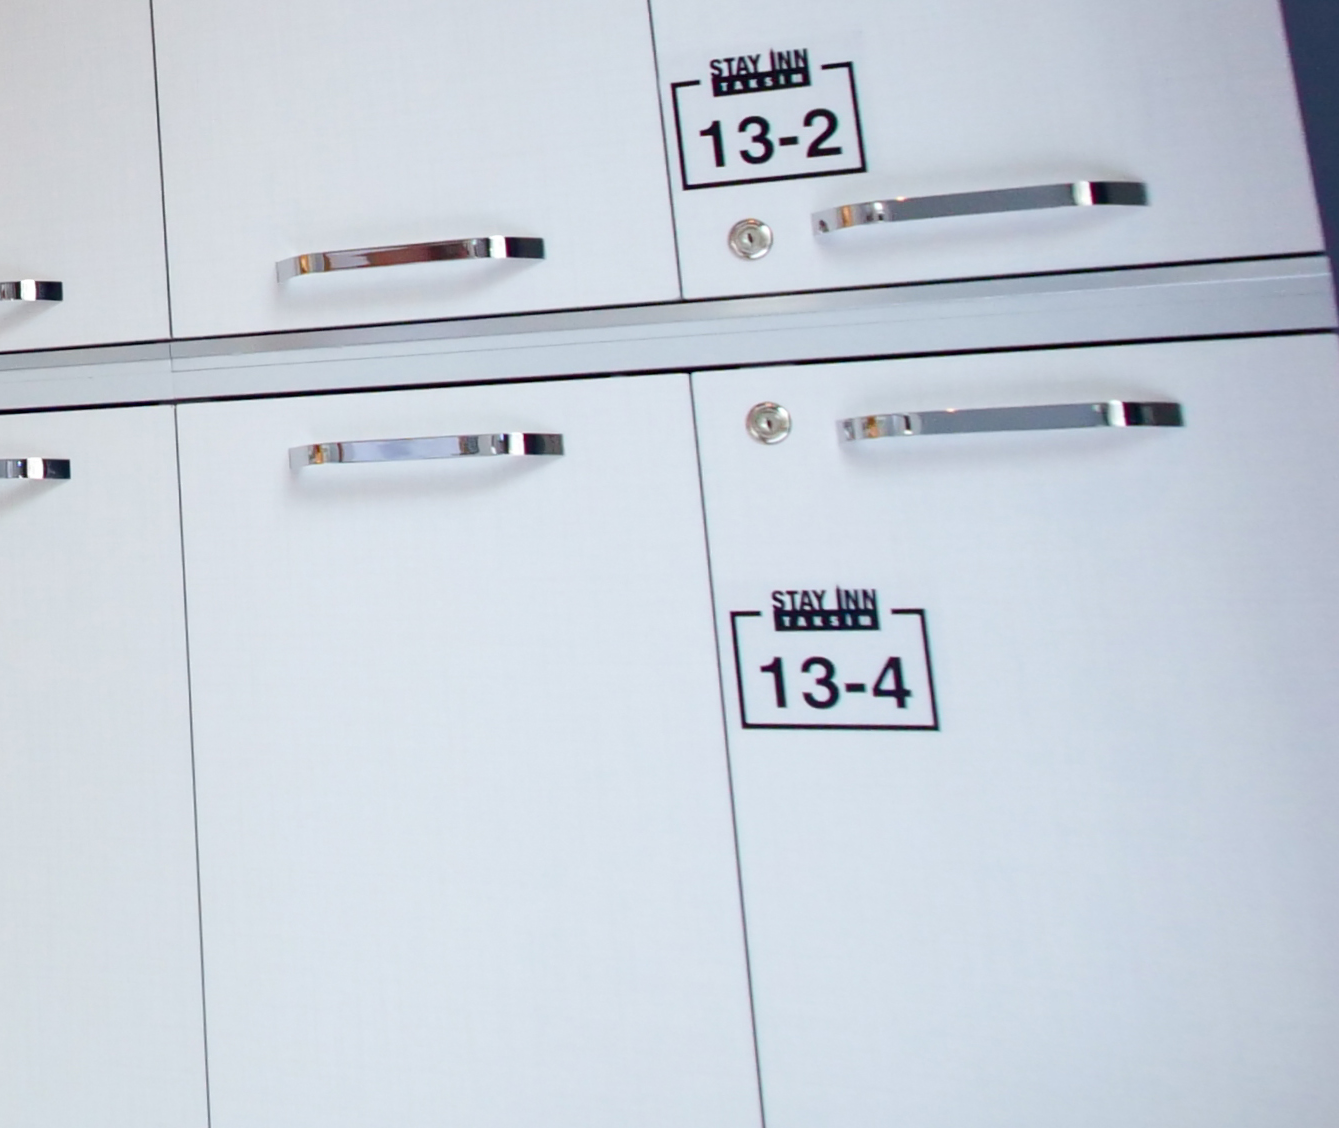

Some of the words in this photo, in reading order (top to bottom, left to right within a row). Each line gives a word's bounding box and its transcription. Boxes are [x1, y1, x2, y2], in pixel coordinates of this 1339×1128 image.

[710, 54, 761, 78] STAY
[699, 108, 843, 168] 13-2
[771, 590, 826, 611] STAY
[760, 656, 913, 709] 13-4
